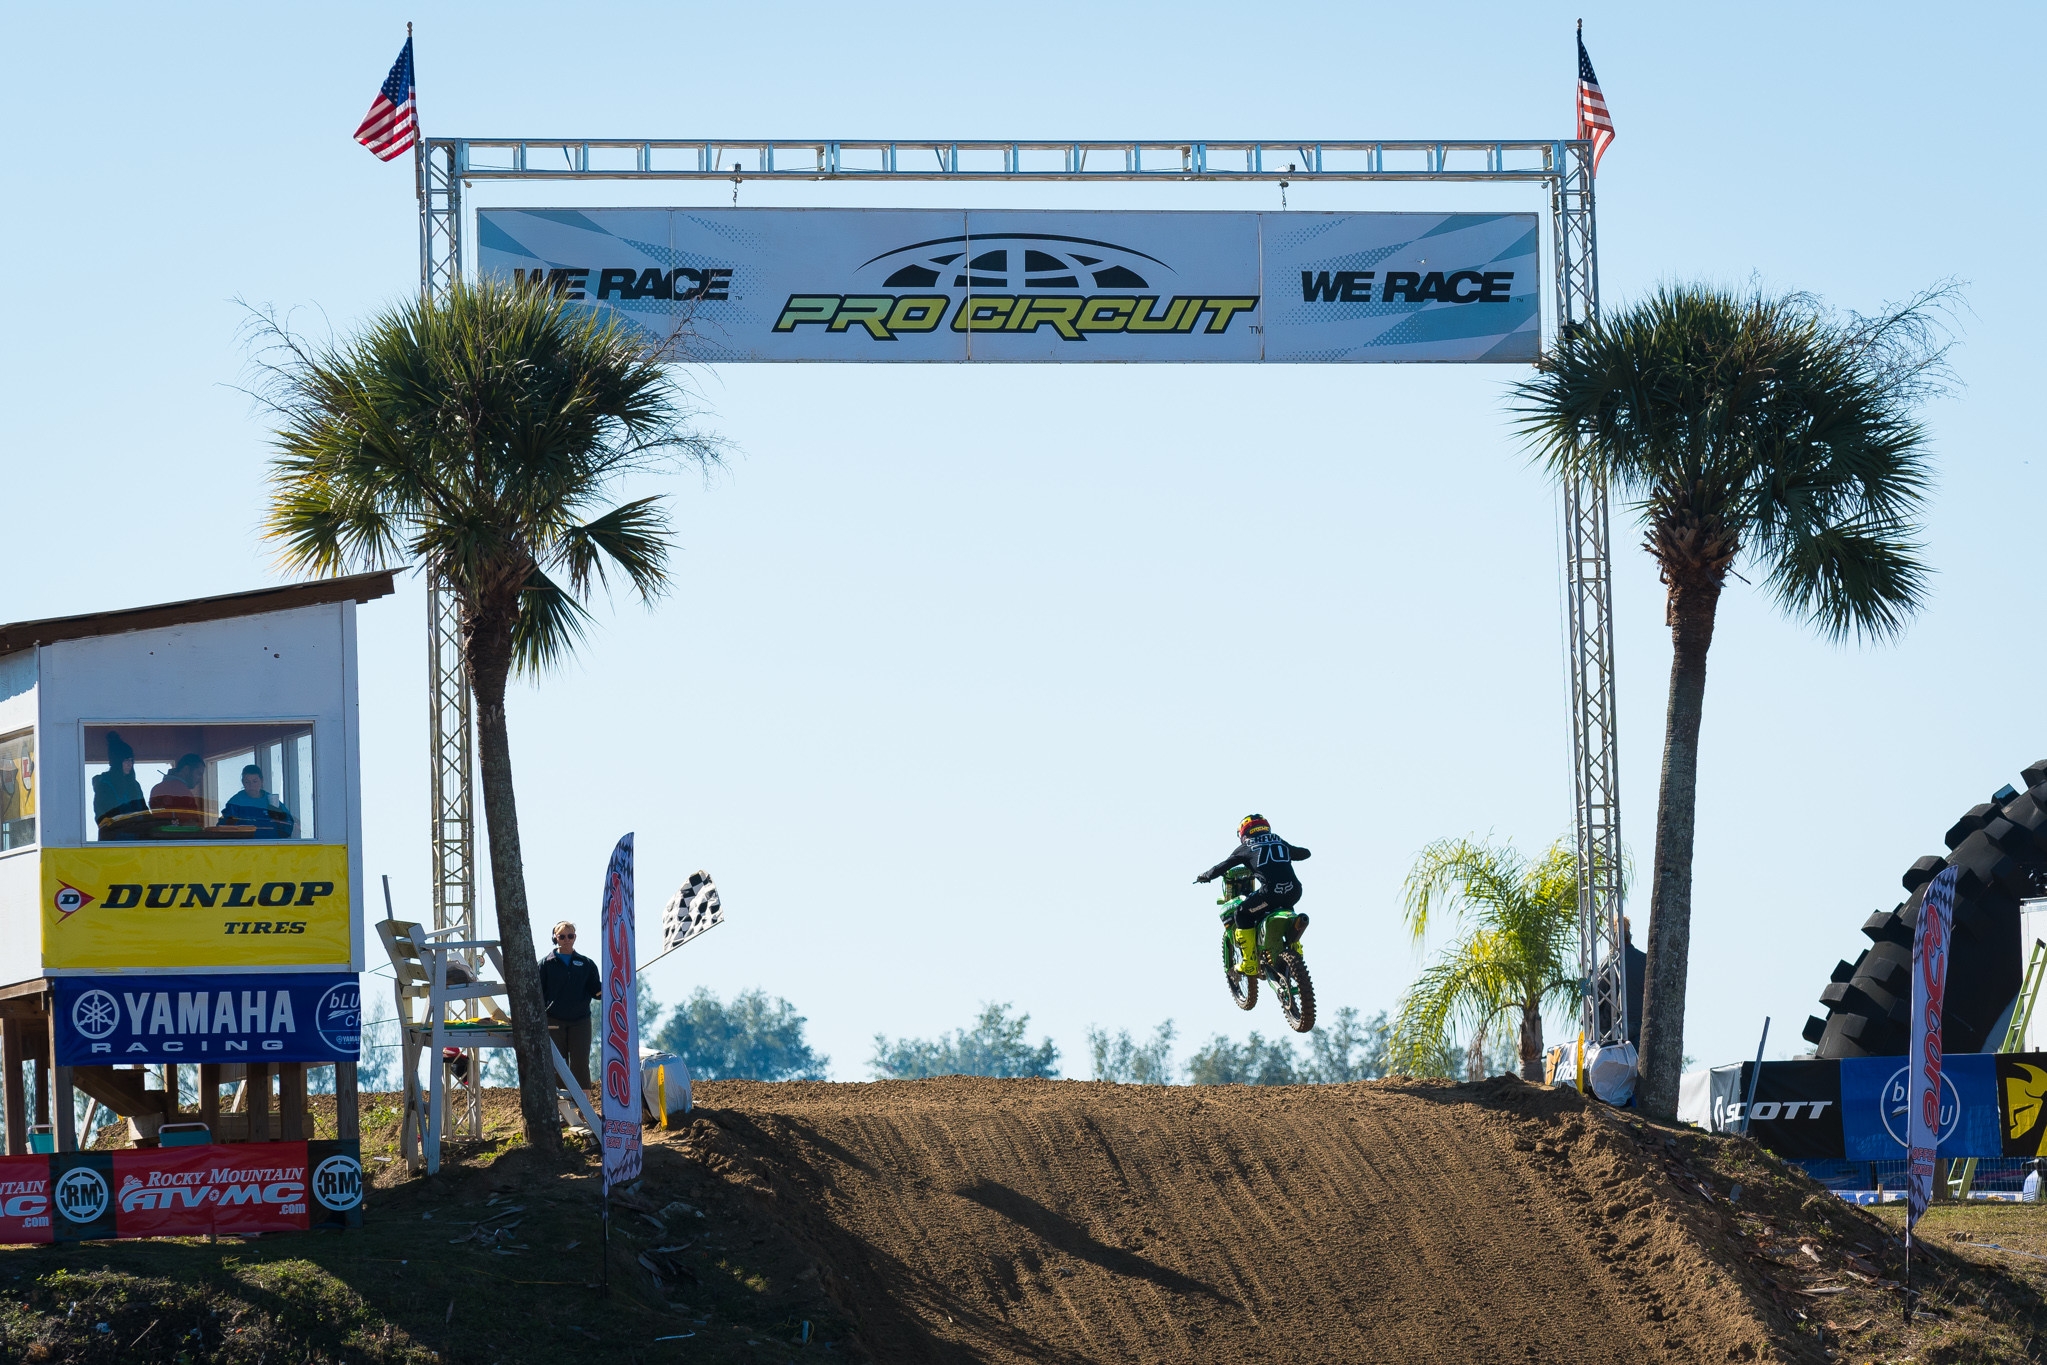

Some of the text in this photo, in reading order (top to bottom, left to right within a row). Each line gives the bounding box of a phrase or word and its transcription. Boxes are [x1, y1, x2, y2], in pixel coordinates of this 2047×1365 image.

[597, 268, 733, 300] RACE
[1301, 271, 1375, 302] WE
[1382, 271, 1514, 303] RACE
[771, 294, 951, 341] PRO
[950, 294, 1260, 341] CIRCUIT
[1251, 843, 1290, 867] 70
[99, 881, 334, 909] DUNLOP
[224, 921, 307, 935] TIRES
[124, 990, 296, 1036] YAMAHA
[91, 1040, 285, 1053] RACING
[1725, 1101, 1832, 1123] SCOTT
[146, 1167, 305, 1187] ROCKY MOUNTAIN
[279, 1203, 306, 1214] .com
[22, 1216, 49, 1228] .com
